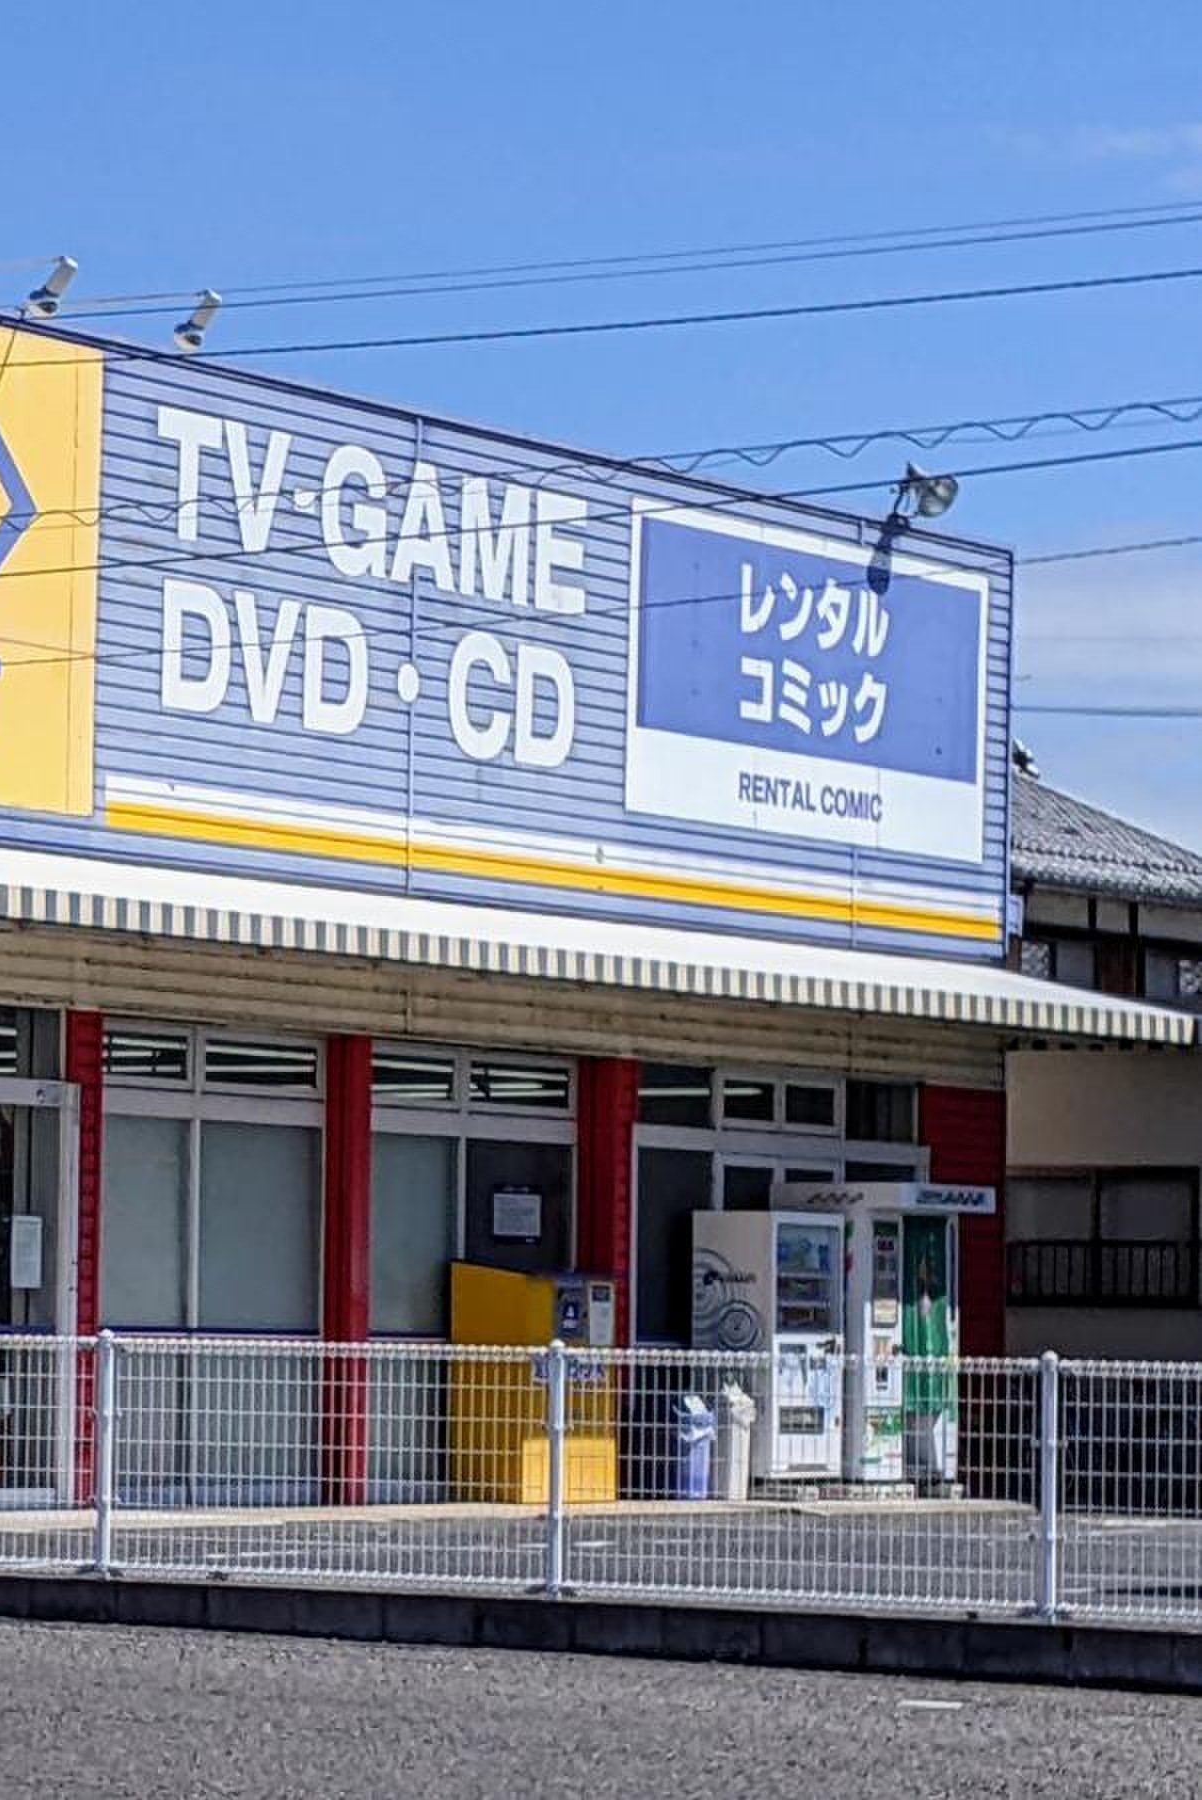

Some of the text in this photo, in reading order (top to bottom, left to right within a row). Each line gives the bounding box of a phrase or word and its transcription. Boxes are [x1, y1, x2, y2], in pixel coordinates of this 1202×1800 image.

[741, 563, 889, 657] レンタル
[740, 656, 886, 743] コミック
[738, 771, 883, 823] RENTAL COMIC
